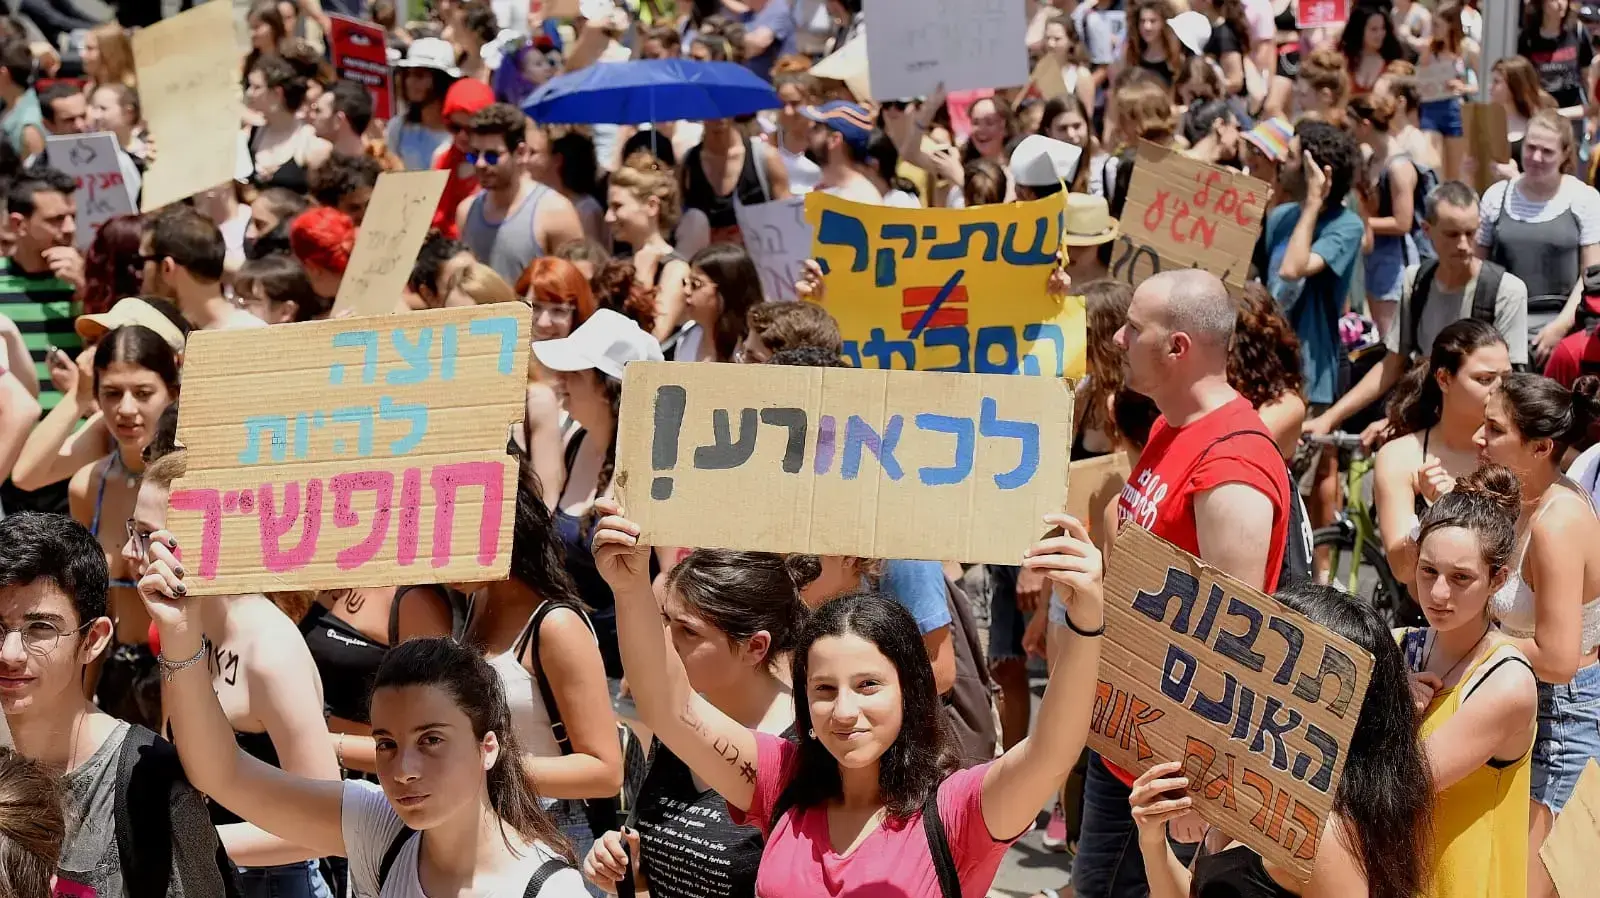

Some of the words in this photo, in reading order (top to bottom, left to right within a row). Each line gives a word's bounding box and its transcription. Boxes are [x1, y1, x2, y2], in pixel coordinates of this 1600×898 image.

[328, 317, 519, 385] רוצה
[237, 396, 428, 465] להיות
[650, 384, 1040, 500] לכאורע!
[1131, 565, 1358, 720] תרבות
[1160, 642, 1340, 794] האונס
[1181, 735, 1321, 861] הורגת
